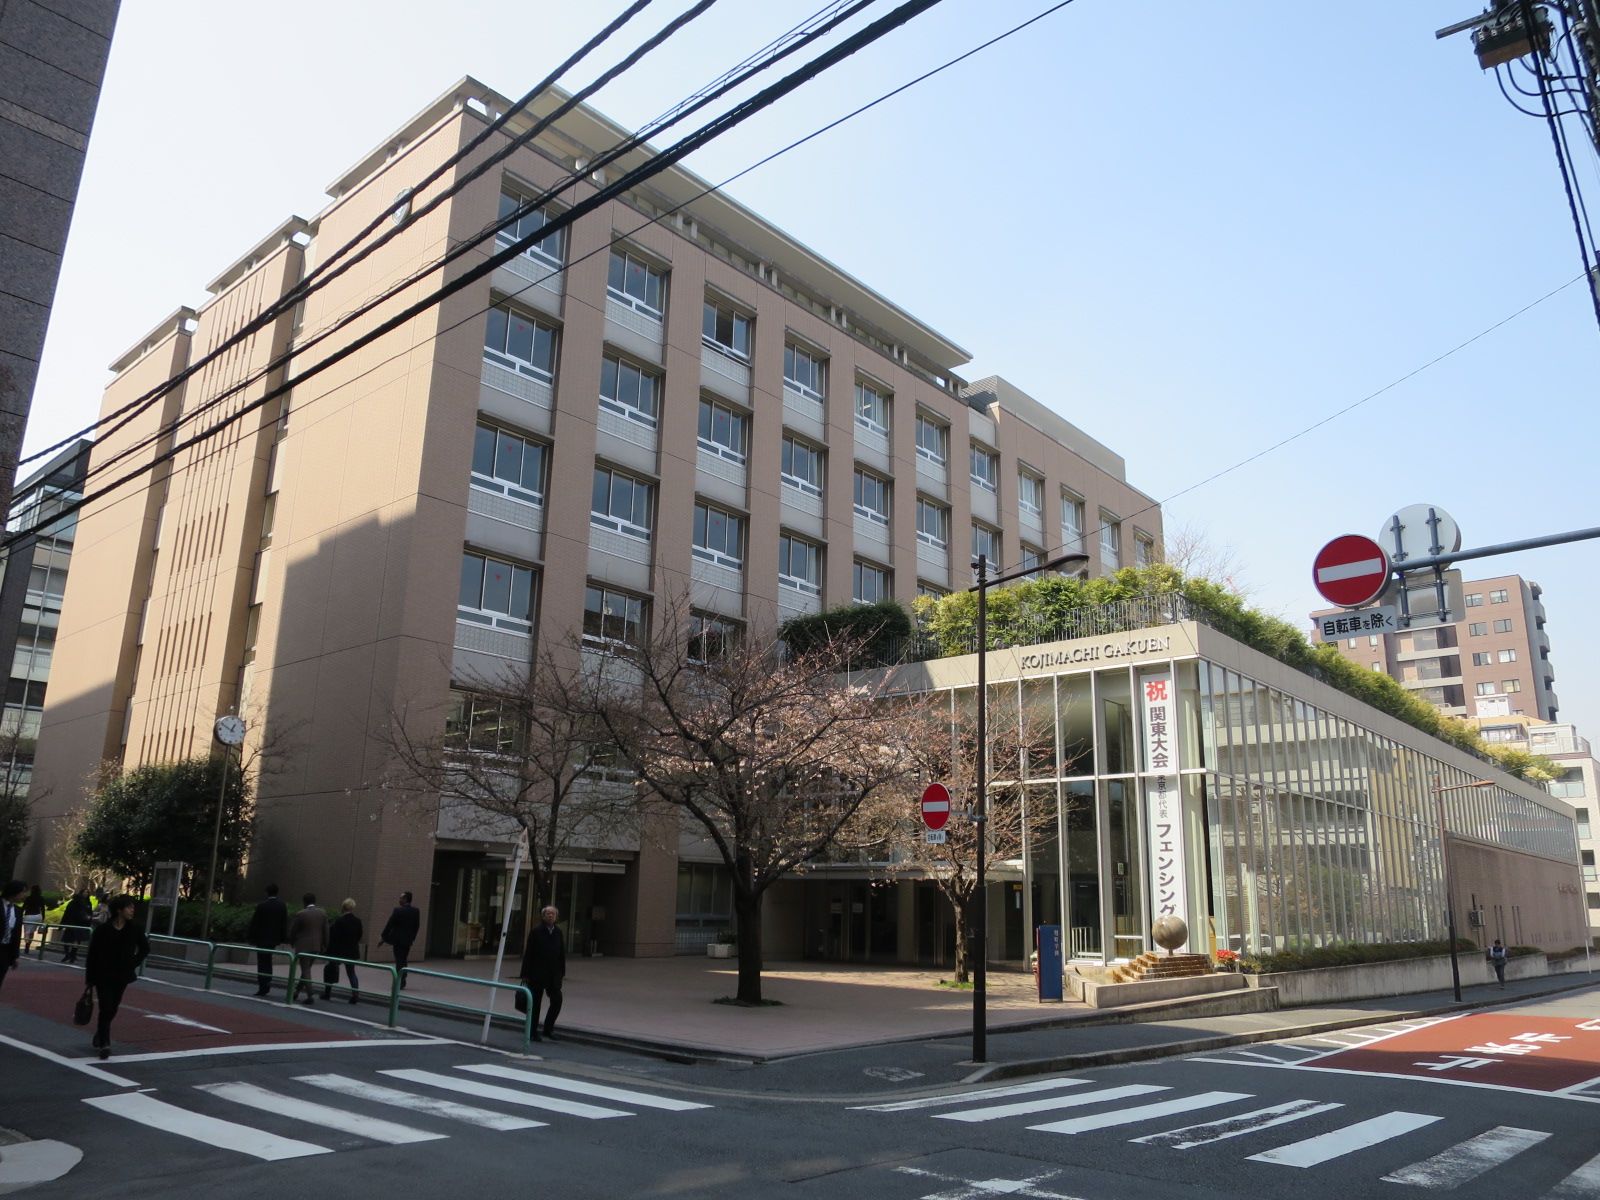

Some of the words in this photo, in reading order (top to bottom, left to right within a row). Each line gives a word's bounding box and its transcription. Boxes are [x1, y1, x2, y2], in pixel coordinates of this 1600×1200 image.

[1323, 613, 1393, 635] 自転車を除く
[1020, 646, 1100, 671] KOJIMACHI
[1104, 636, 1170, 658] GAKUEN
[1145, 680, 1168, 701] 祝
[1149, 706, 1169, 769] 関東大会
